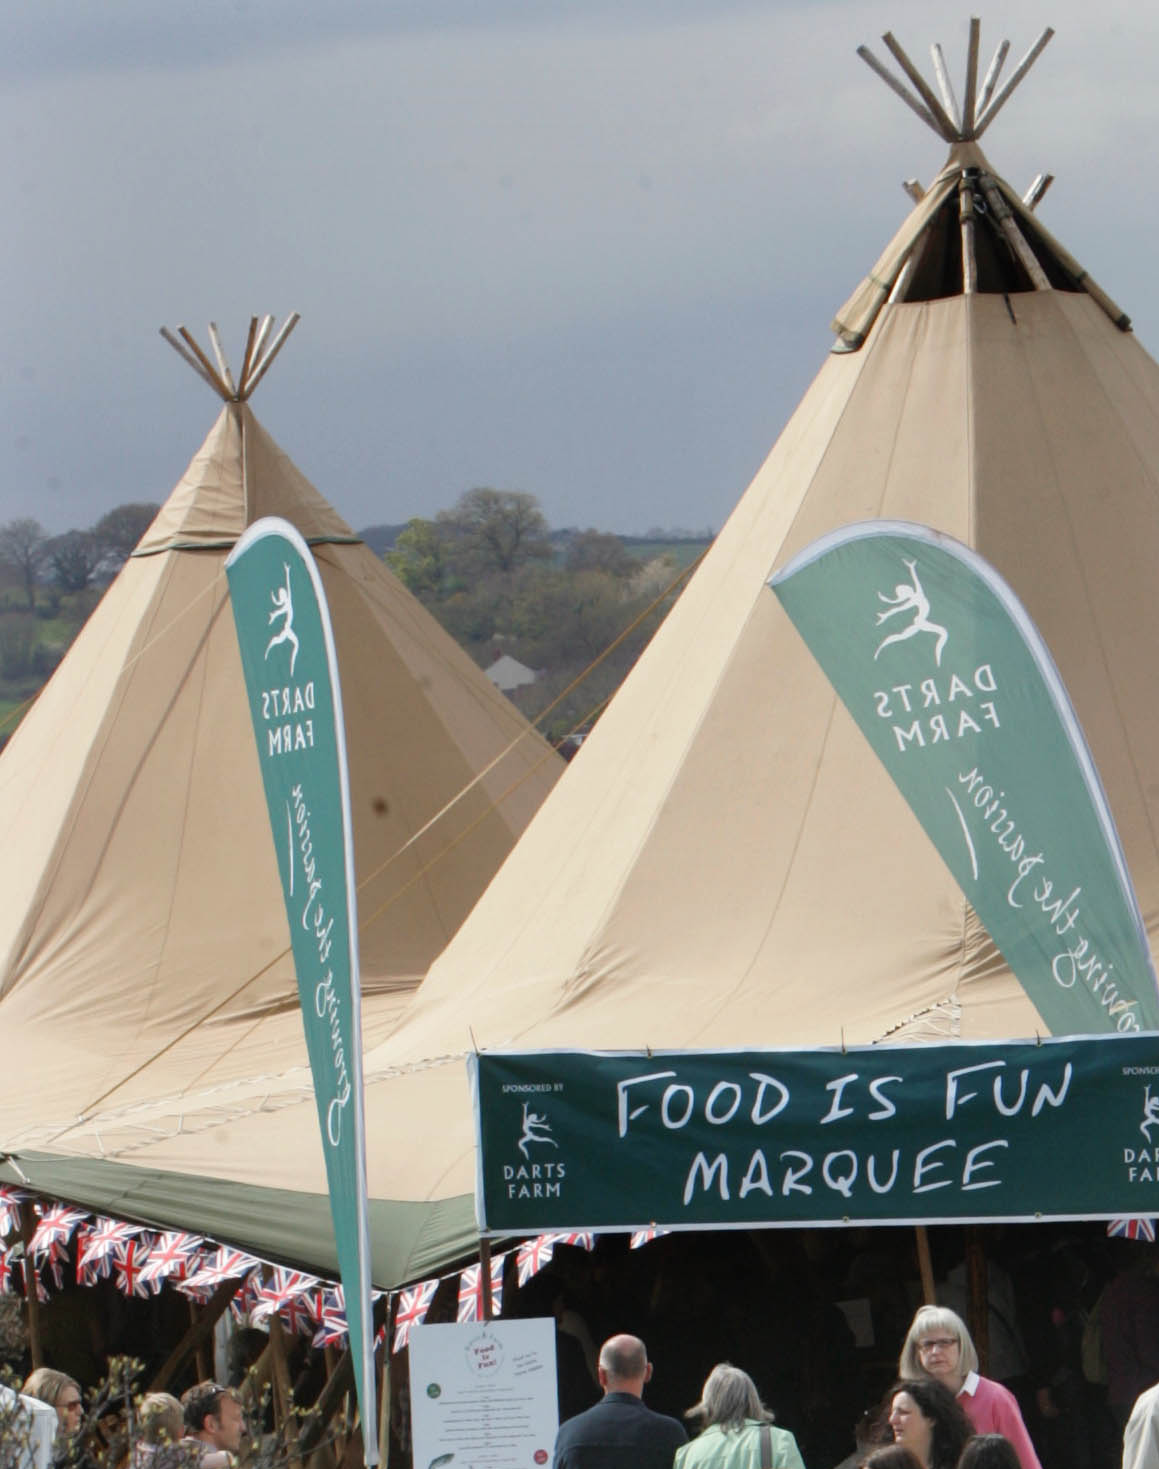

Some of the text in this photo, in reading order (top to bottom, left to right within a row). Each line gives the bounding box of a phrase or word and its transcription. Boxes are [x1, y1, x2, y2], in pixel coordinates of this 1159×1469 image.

[502, 1083, 564, 1092] SPONSORED BY
[617, 1060, 1073, 1138] FOOD IS FUN
[503, 1163, 567, 1180] DARTS
[683, 1140, 1009, 1206] MARQUEE
[508, 1183, 560, 1199] FARM
